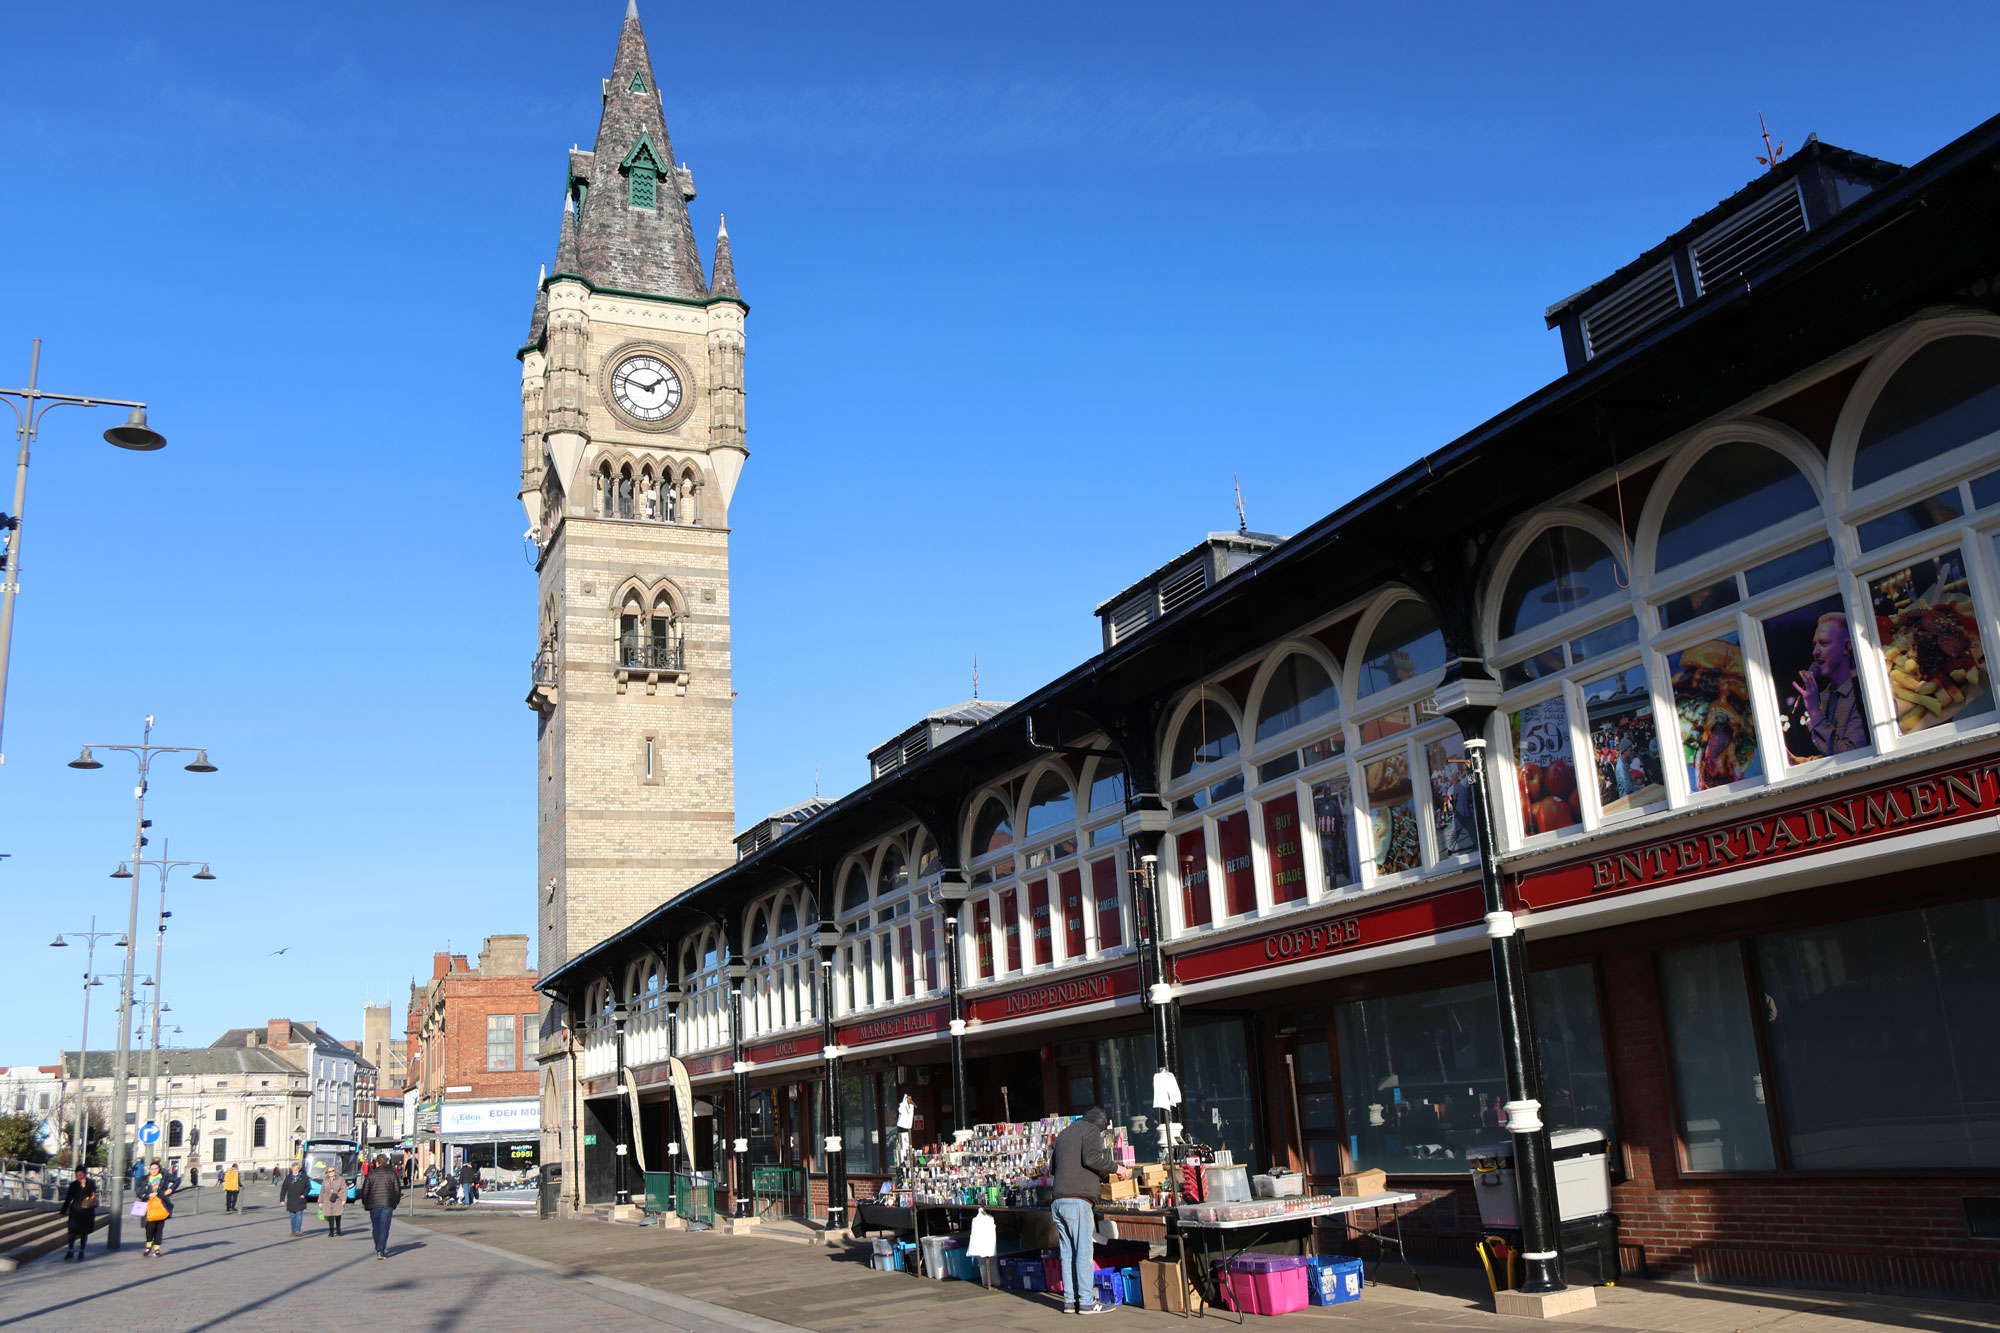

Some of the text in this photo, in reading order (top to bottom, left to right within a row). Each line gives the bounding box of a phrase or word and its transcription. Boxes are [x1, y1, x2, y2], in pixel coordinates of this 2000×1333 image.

[1275, 812, 1291, 831] BUY
[1276, 842, 1297, 859] SELL
[1226, 855, 1250, 874] RETRO
[1276, 867, 1303, 887] TRADE
[1069, 895, 1078, 908] CD
[1069, 917, 1081, 931] DVD
[1264, 917, 1361, 961] COFFEE
[1005, 974, 1110, 1014] INDEPENDENT
[859, 1010, 933, 1041] MARKET HALL
[775, 1040, 797, 1057] LOCAL
[459, 1113, 481, 1121] Eden
[489, 1108, 517, 1118] EDEN
[511, 1150, 533, 1159] £995!
